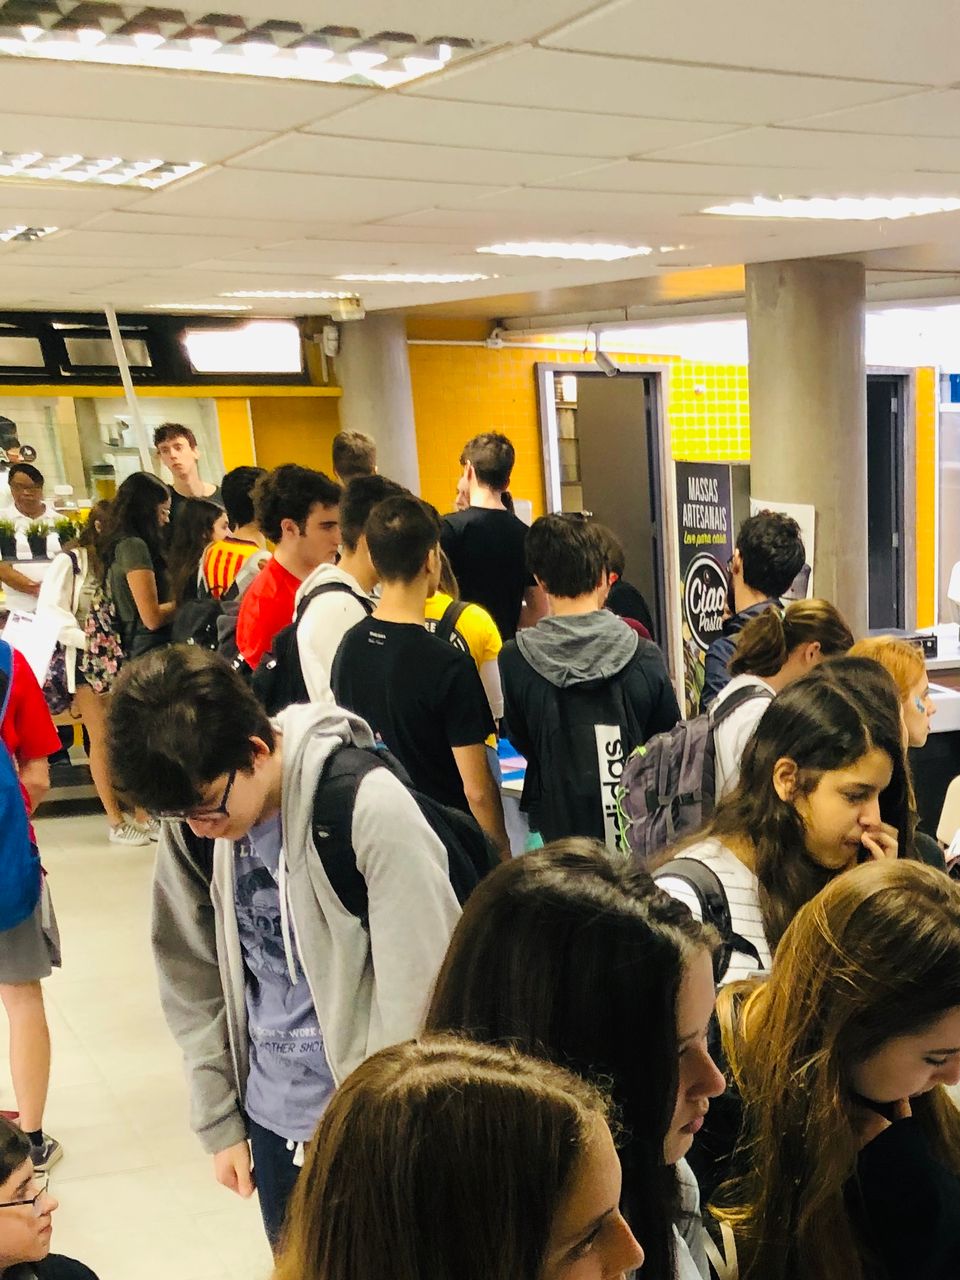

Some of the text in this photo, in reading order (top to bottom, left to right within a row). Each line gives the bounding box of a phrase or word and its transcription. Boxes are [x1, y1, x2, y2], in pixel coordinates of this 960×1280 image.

[688, 477, 719, 503] MASSAS
[683, 503, 727, 532] ARTESANAIS
[696, 533, 711, 547] para
[690, 577, 725, 615] Ciao
[698, 612, 723, 633] Pasta
[290, 1027, 317, 1038] WORK
